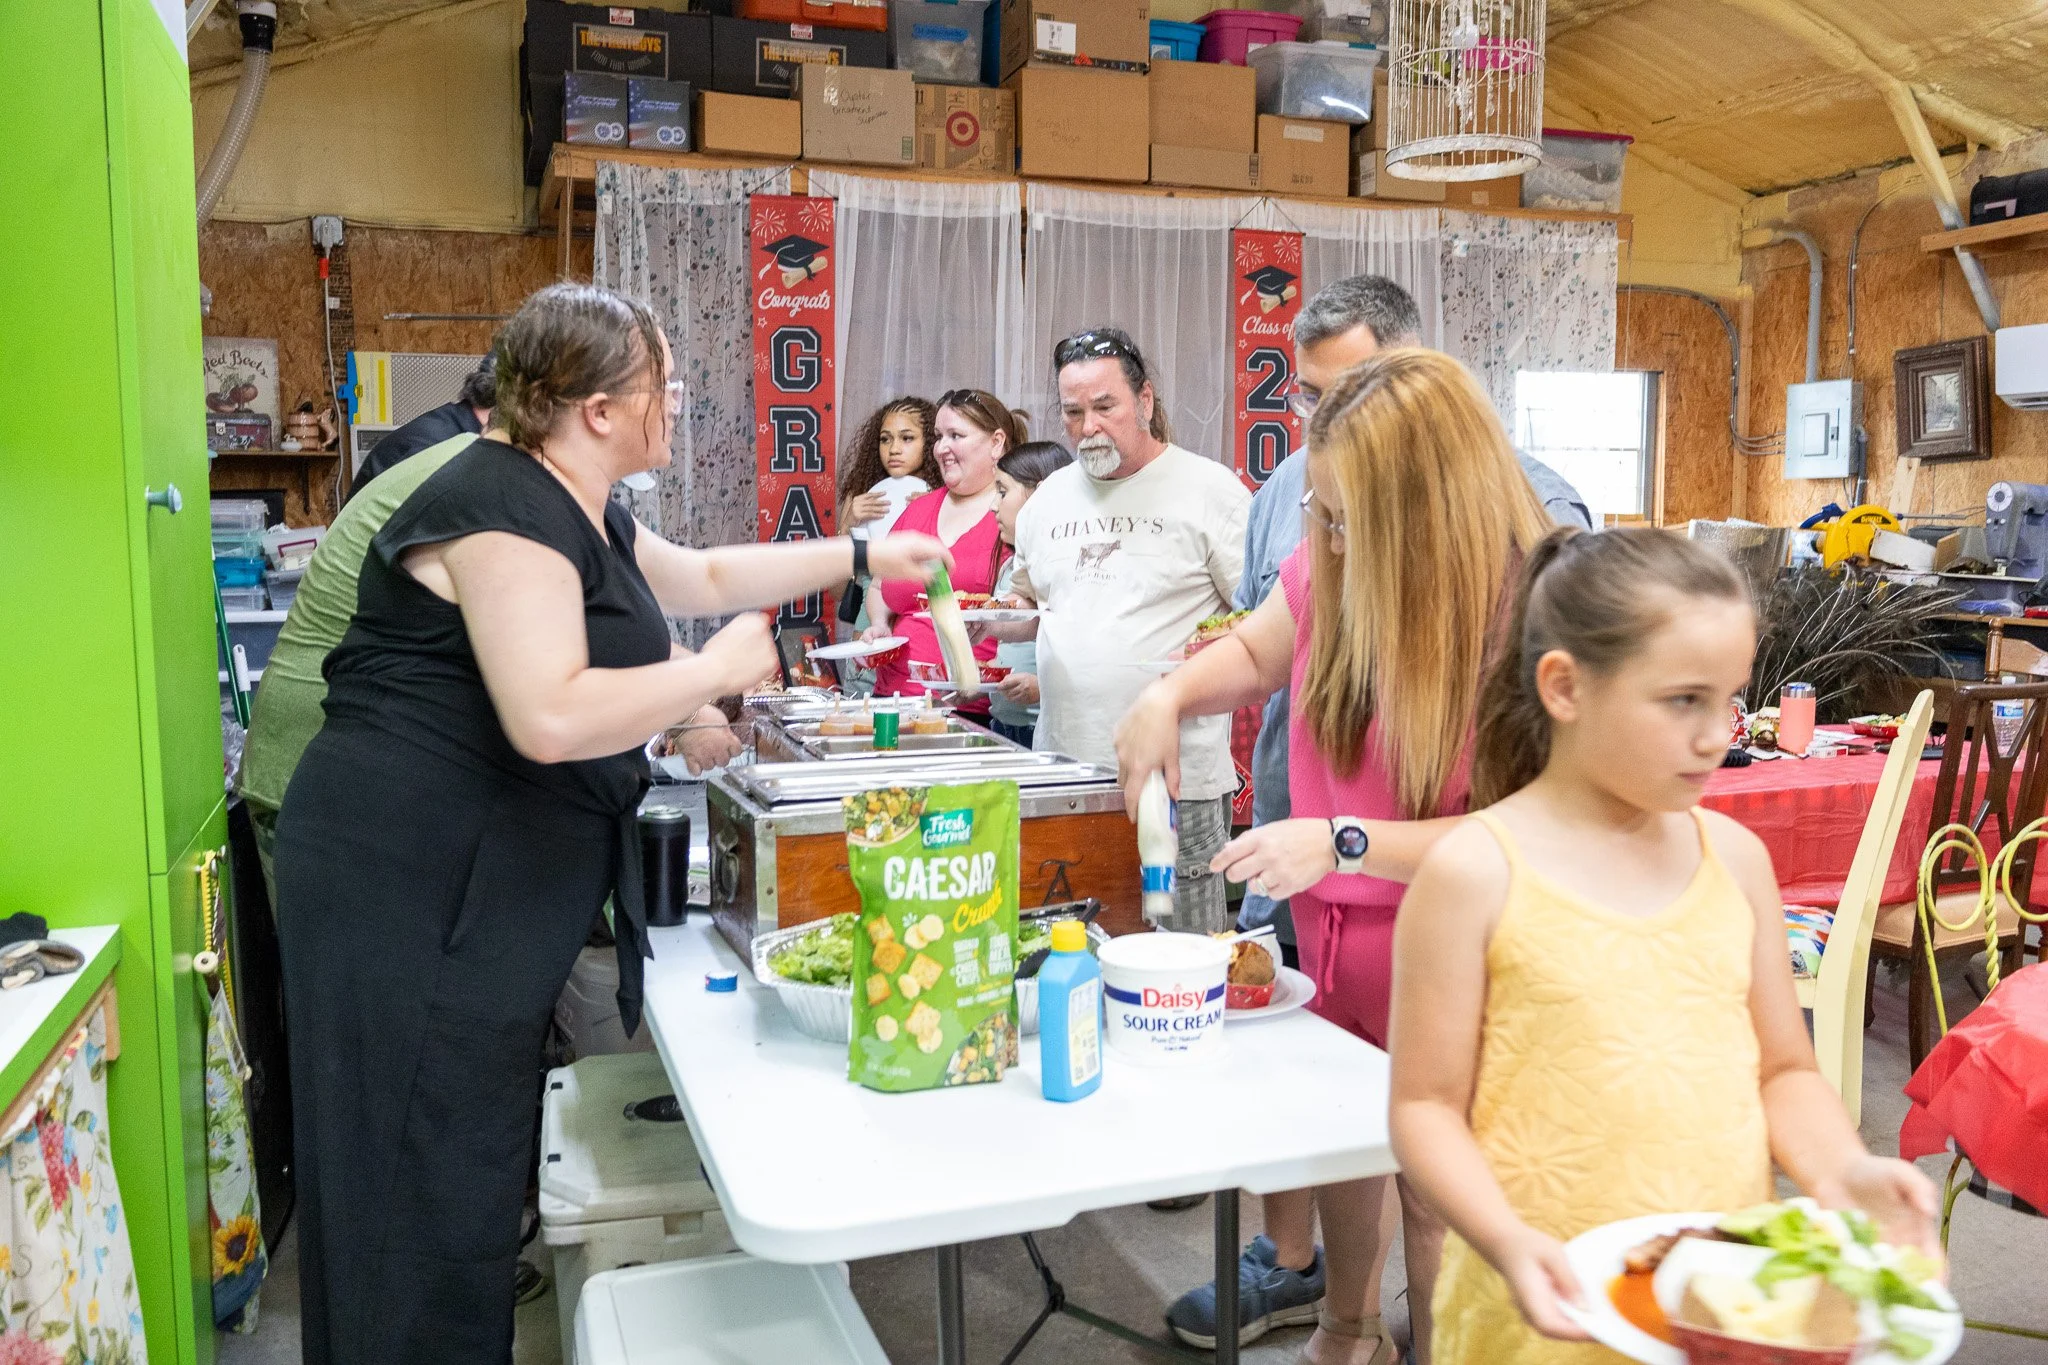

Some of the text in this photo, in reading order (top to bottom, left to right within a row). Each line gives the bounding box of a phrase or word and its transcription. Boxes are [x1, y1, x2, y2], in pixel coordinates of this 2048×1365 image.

[758, 288, 831, 318] Congrats
[1243, 316, 1280, 334] Class
[230, 350, 269, 379] Beets
[1051, 516, 1164, 540] CHANEY'S
[929, 813, 966, 832] Fresh
[884, 851, 996, 901] CAESAR
[1143, 987, 1206, 1011] Daisy
[1123, 1013, 1169, 1032] SOUR
